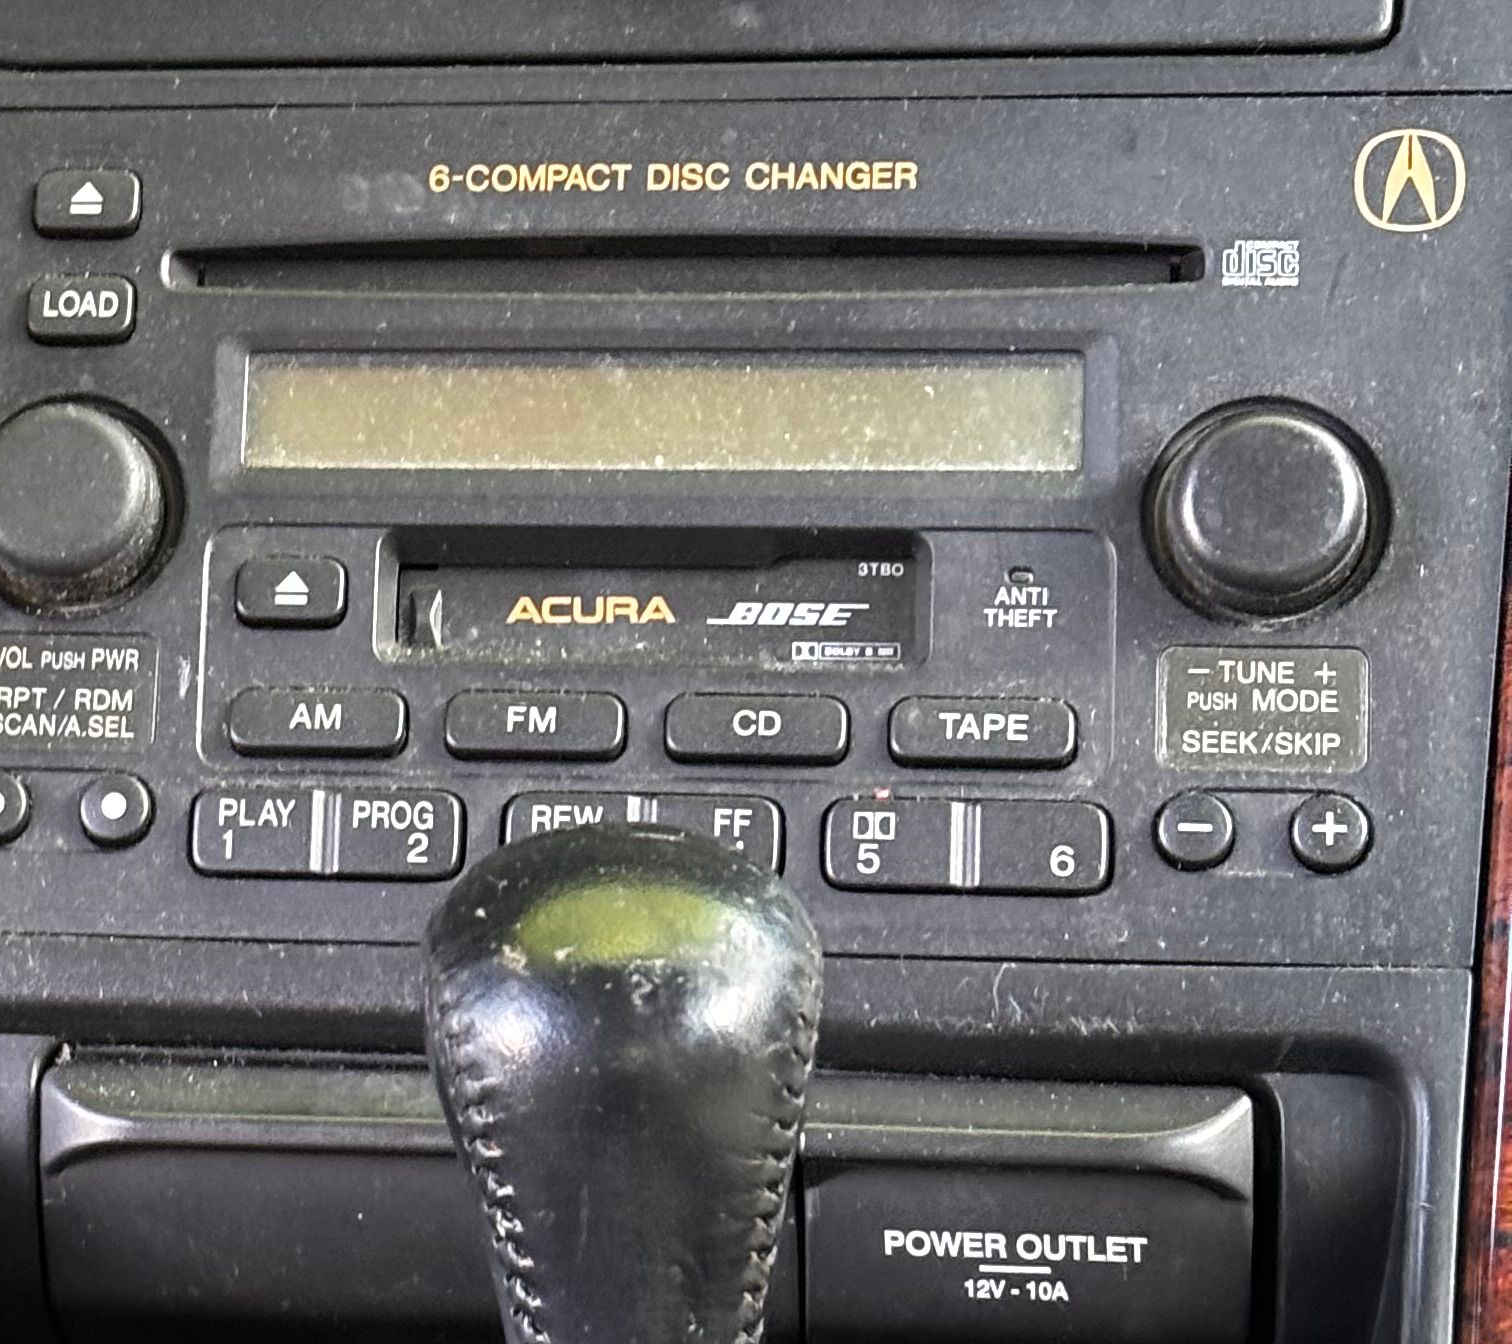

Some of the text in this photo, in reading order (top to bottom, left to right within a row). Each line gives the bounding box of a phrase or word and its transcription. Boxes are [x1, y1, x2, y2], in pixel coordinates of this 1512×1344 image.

[428, 160, 918, 193] 6-COMPACT DISC CHANGER
[42, 289, 119, 318] LOAD
[505, 595, 676, 625] ACURA
[993, 586, 1049, 607] ANTI
[706, 602, 870, 626] BOSE
[983, 607, 1058, 629] THEFT
[40, 650, 86, 671] PUSH
[91, 647, 139, 673] PWR
[1217, 660, 1295, 685] TUNE
[74, 688, 133, 712] RDM
[1186, 687, 1340, 713] PUSH MODE
[288, 702, 342, 730] AM
[506, 705, 557, 734] FM
[732, 709, 782, 737] CD
[938, 712, 1030, 742] TAPE
[1181, 729, 1341, 756] SEEK/SKIP
[218, 797, 296, 828] PLAY
[352, 799, 434, 831] PROG
[713, 807, 753, 838] FF
[222, 829, 233, 860] 1
[406, 832, 429, 864] 2
[856, 842, 881, 875] 5
[1049, 844, 1075, 877] 6
[883, 1229, 1148, 1263] POWER OUTLET
[963, 1278, 1006, 1299] 12V
[1025, 1280, 1069, 1302] 10A
